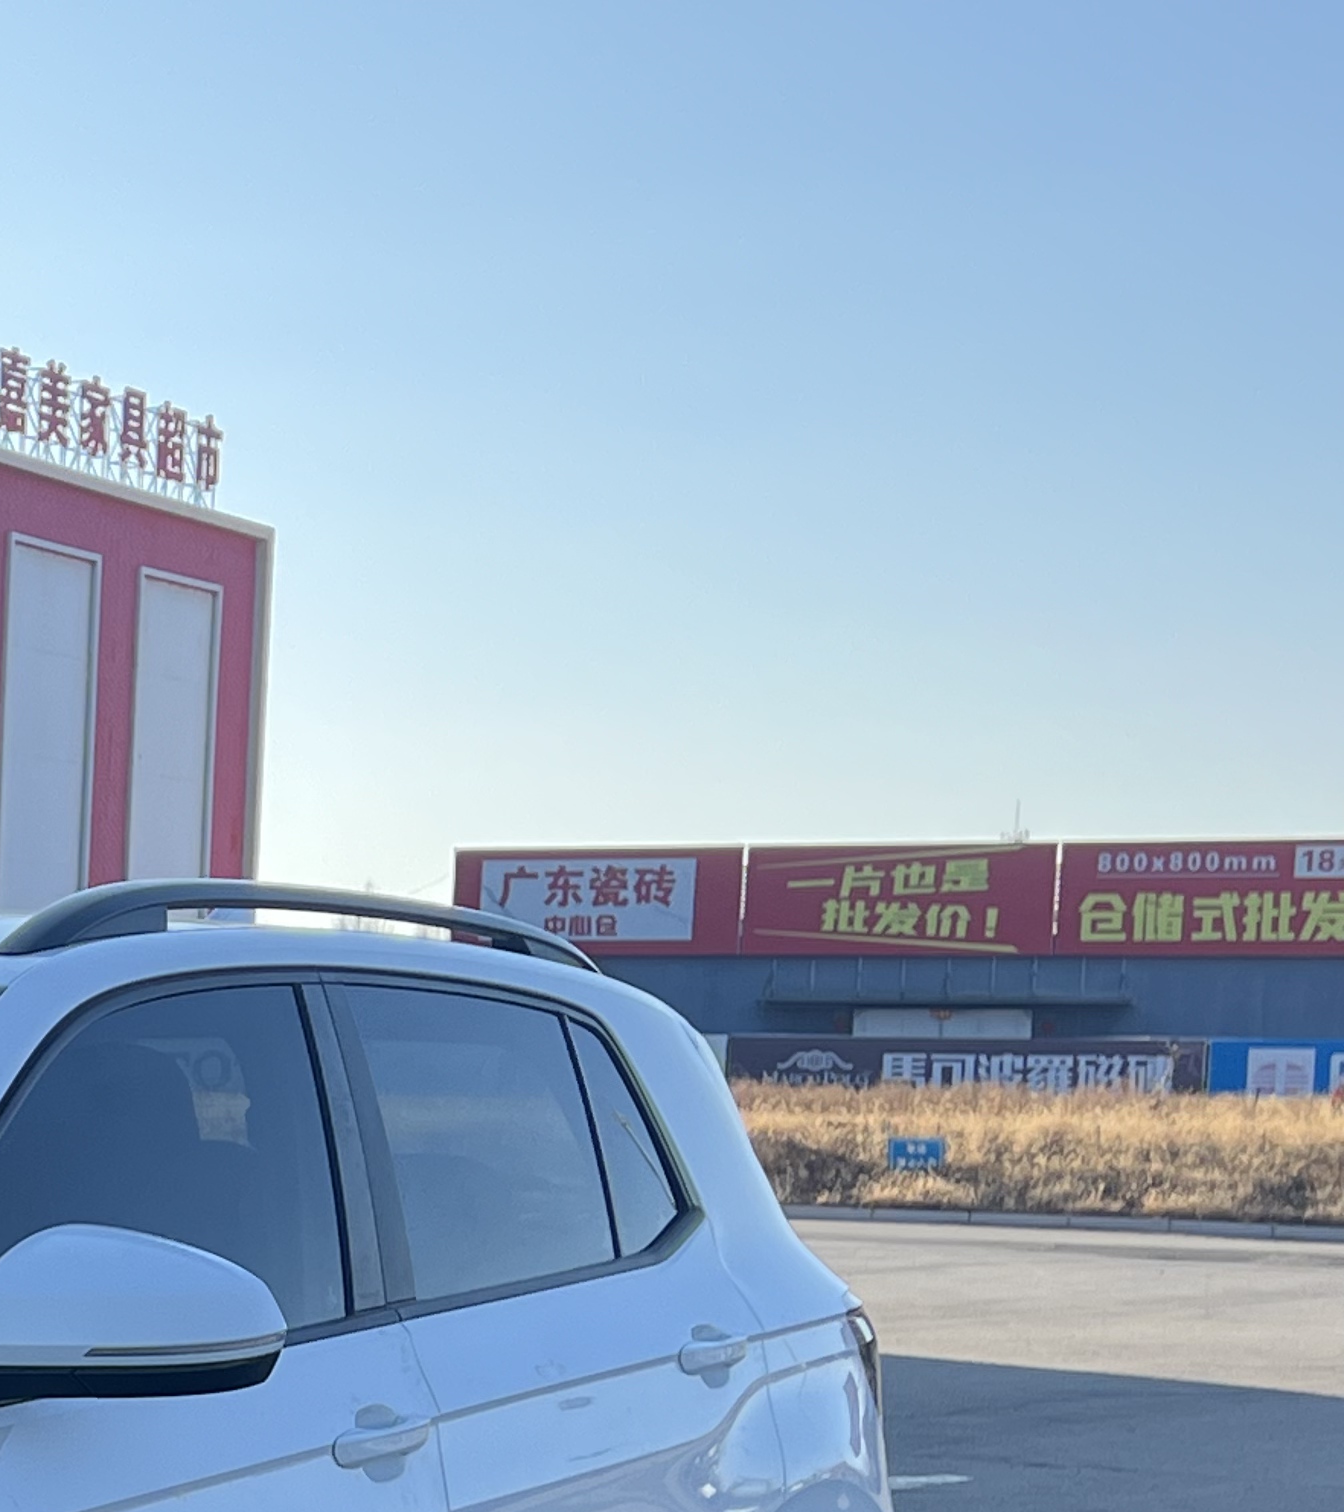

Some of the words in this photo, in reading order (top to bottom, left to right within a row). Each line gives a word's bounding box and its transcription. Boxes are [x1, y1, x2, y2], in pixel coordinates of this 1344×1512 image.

[787, 858, 989, 898] 一片也是
[1302, 849, 1344, 873] 18
[499, 864, 676, 908] 广东瓷砖
[544, 914, 618, 937] 中心仓
[1078, 890, 1344, 942] 仓储式批发
